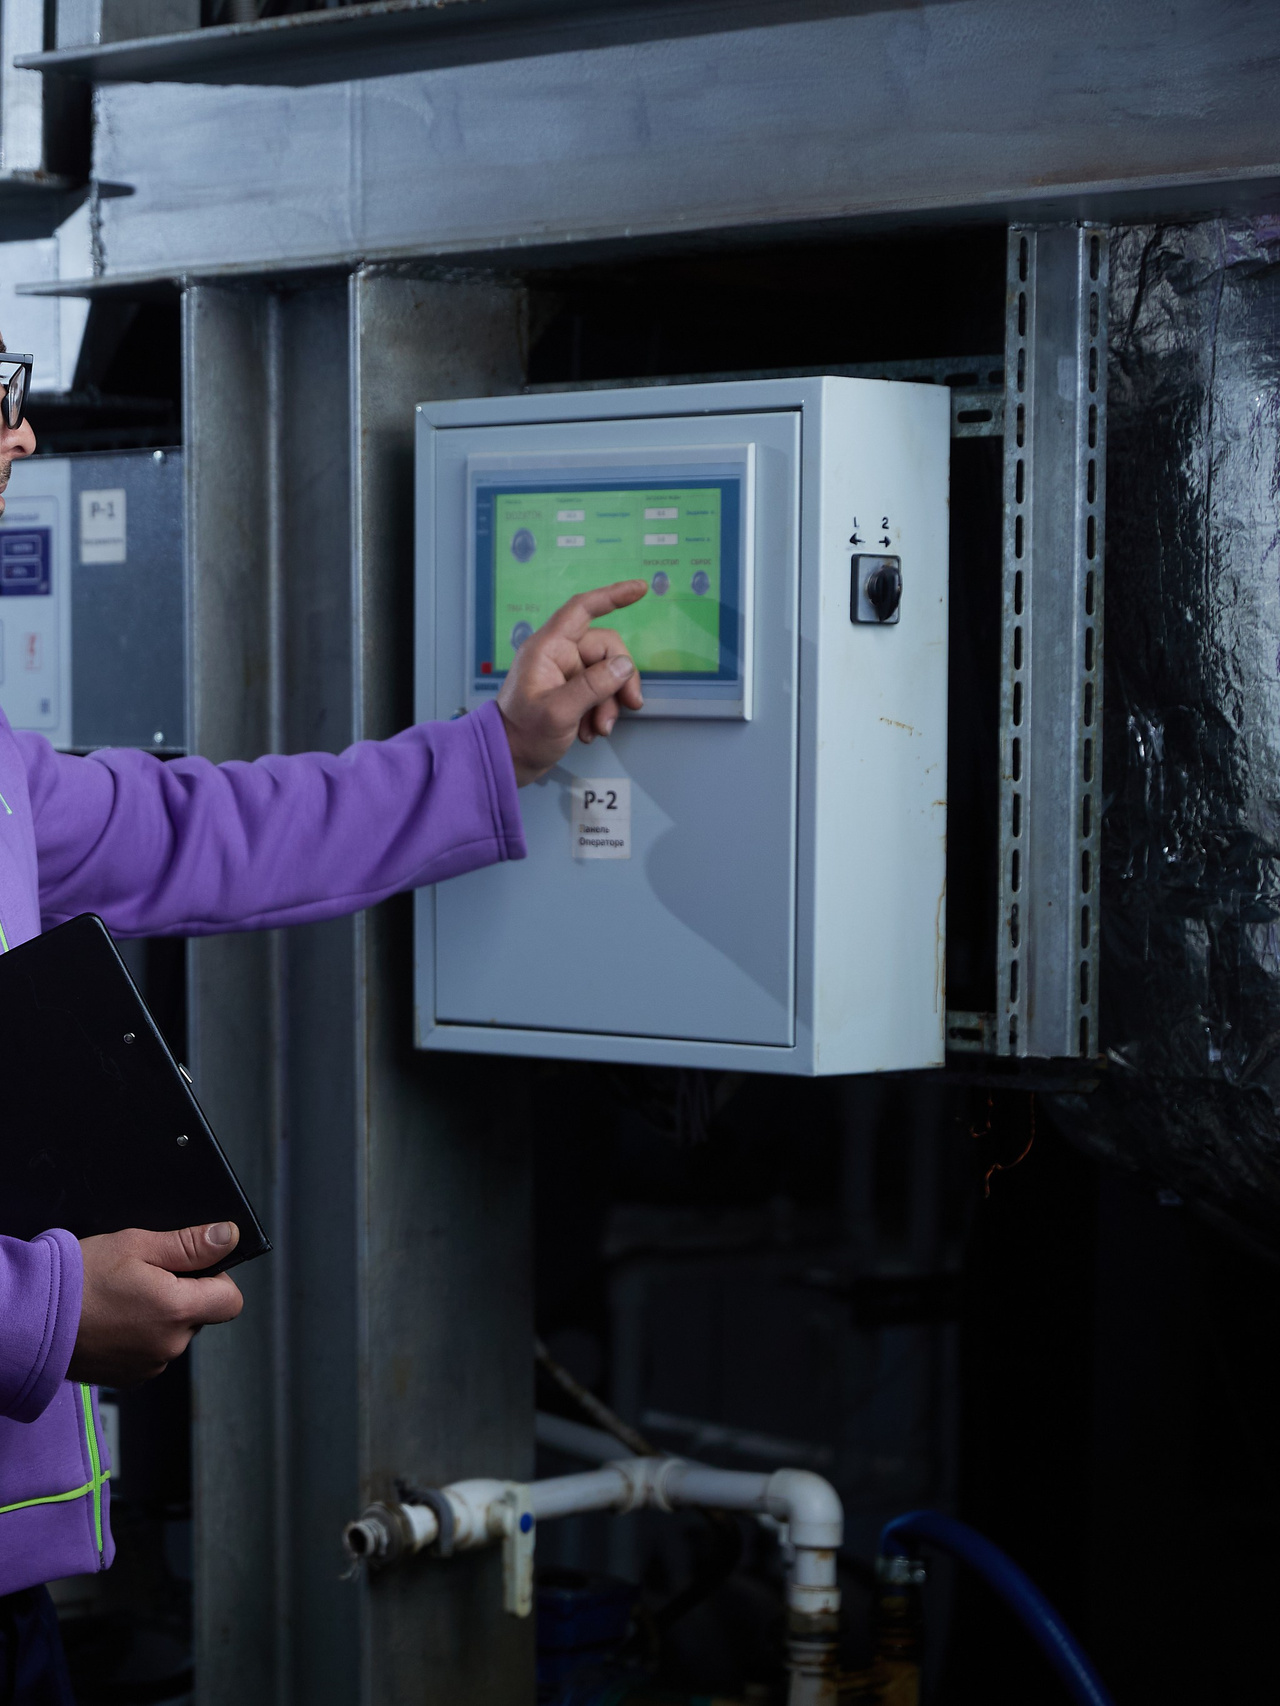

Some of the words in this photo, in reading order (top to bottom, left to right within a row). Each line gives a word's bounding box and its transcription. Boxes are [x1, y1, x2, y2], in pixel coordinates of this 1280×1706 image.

[90, 500, 116, 518] P-1
[881, 516, 890, 530] 2
[583, 789, 618, 811] P-2
[579, 823, 610, 834] Панель
[579, 836, 625, 848] Оператора
